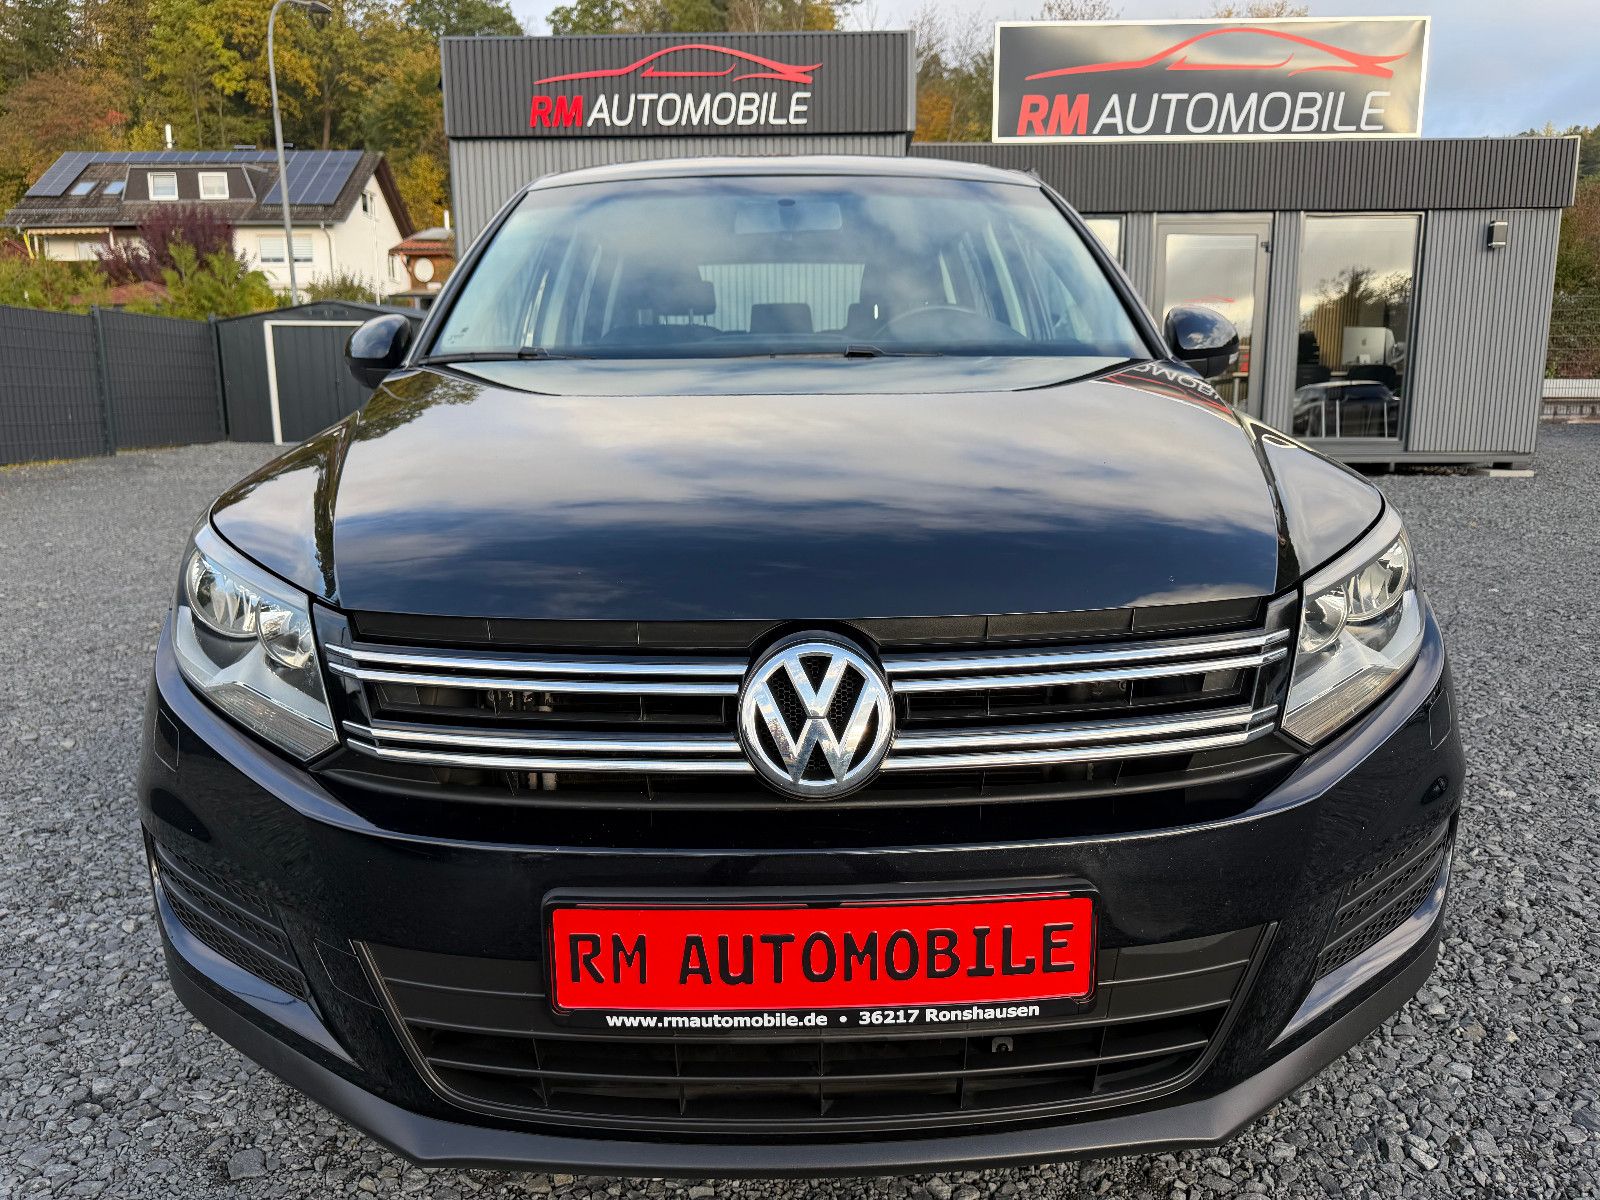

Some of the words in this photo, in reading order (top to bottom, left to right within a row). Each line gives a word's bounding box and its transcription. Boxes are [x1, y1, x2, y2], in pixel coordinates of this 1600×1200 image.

[529, 95, 583, 128] RM
[587, 92, 812, 128] AUTOMOBILE
[1016, 93, 1090, 136] RM
[1092, 90, 1391, 134] AUTOMOBILE
[746, 645, 890, 792] VW
[568, 932, 647, 984] RM
[679, 921, 1075, 986] AUTOMOBILE
[605, 1012, 828, 1028] www.rmautomobile.de
[858, 1009, 920, 1025] 36217
[925, 1005, 1040, 1023] Ronshausen
